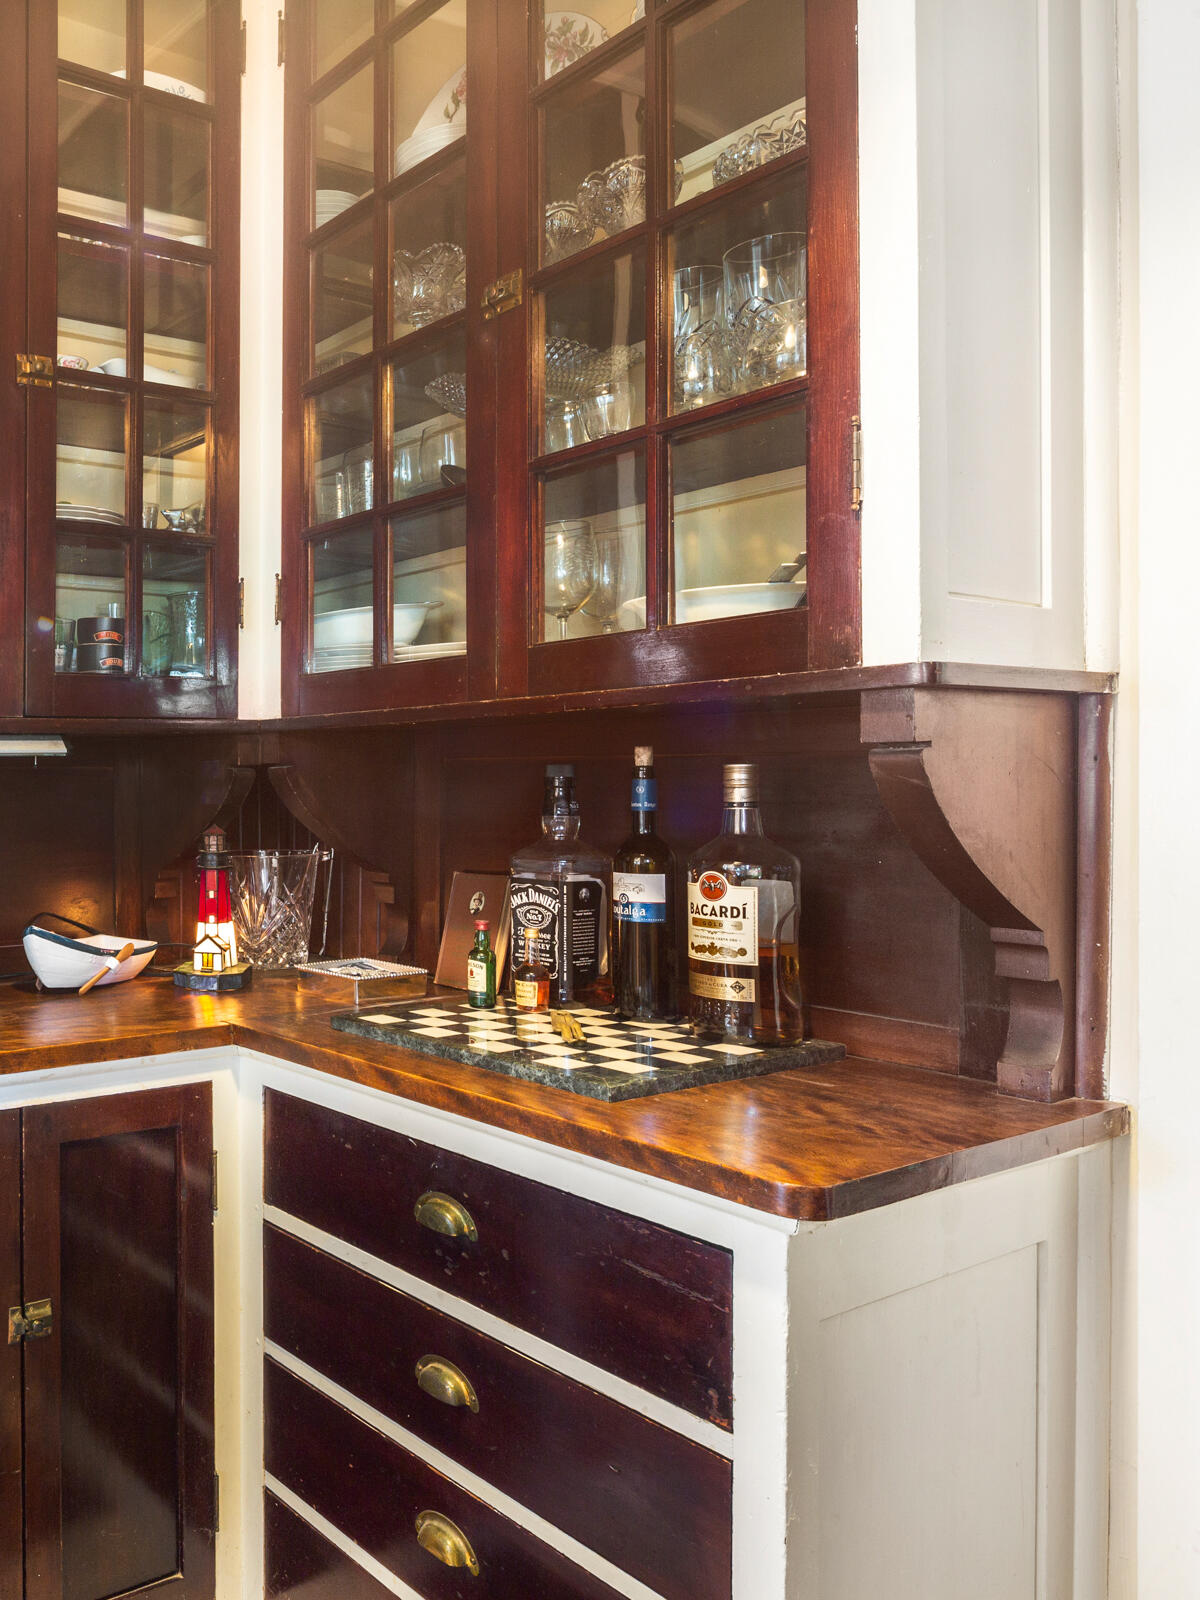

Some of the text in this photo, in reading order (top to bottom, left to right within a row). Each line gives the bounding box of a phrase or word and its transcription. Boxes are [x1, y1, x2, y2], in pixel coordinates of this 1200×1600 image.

[511, 888, 561, 915] JACK DANIEL'S
[613, 904, 646, 919] outalga
[690, 902, 748, 920] BACARDÍ
[702, 920, 724, 928] GOLD
